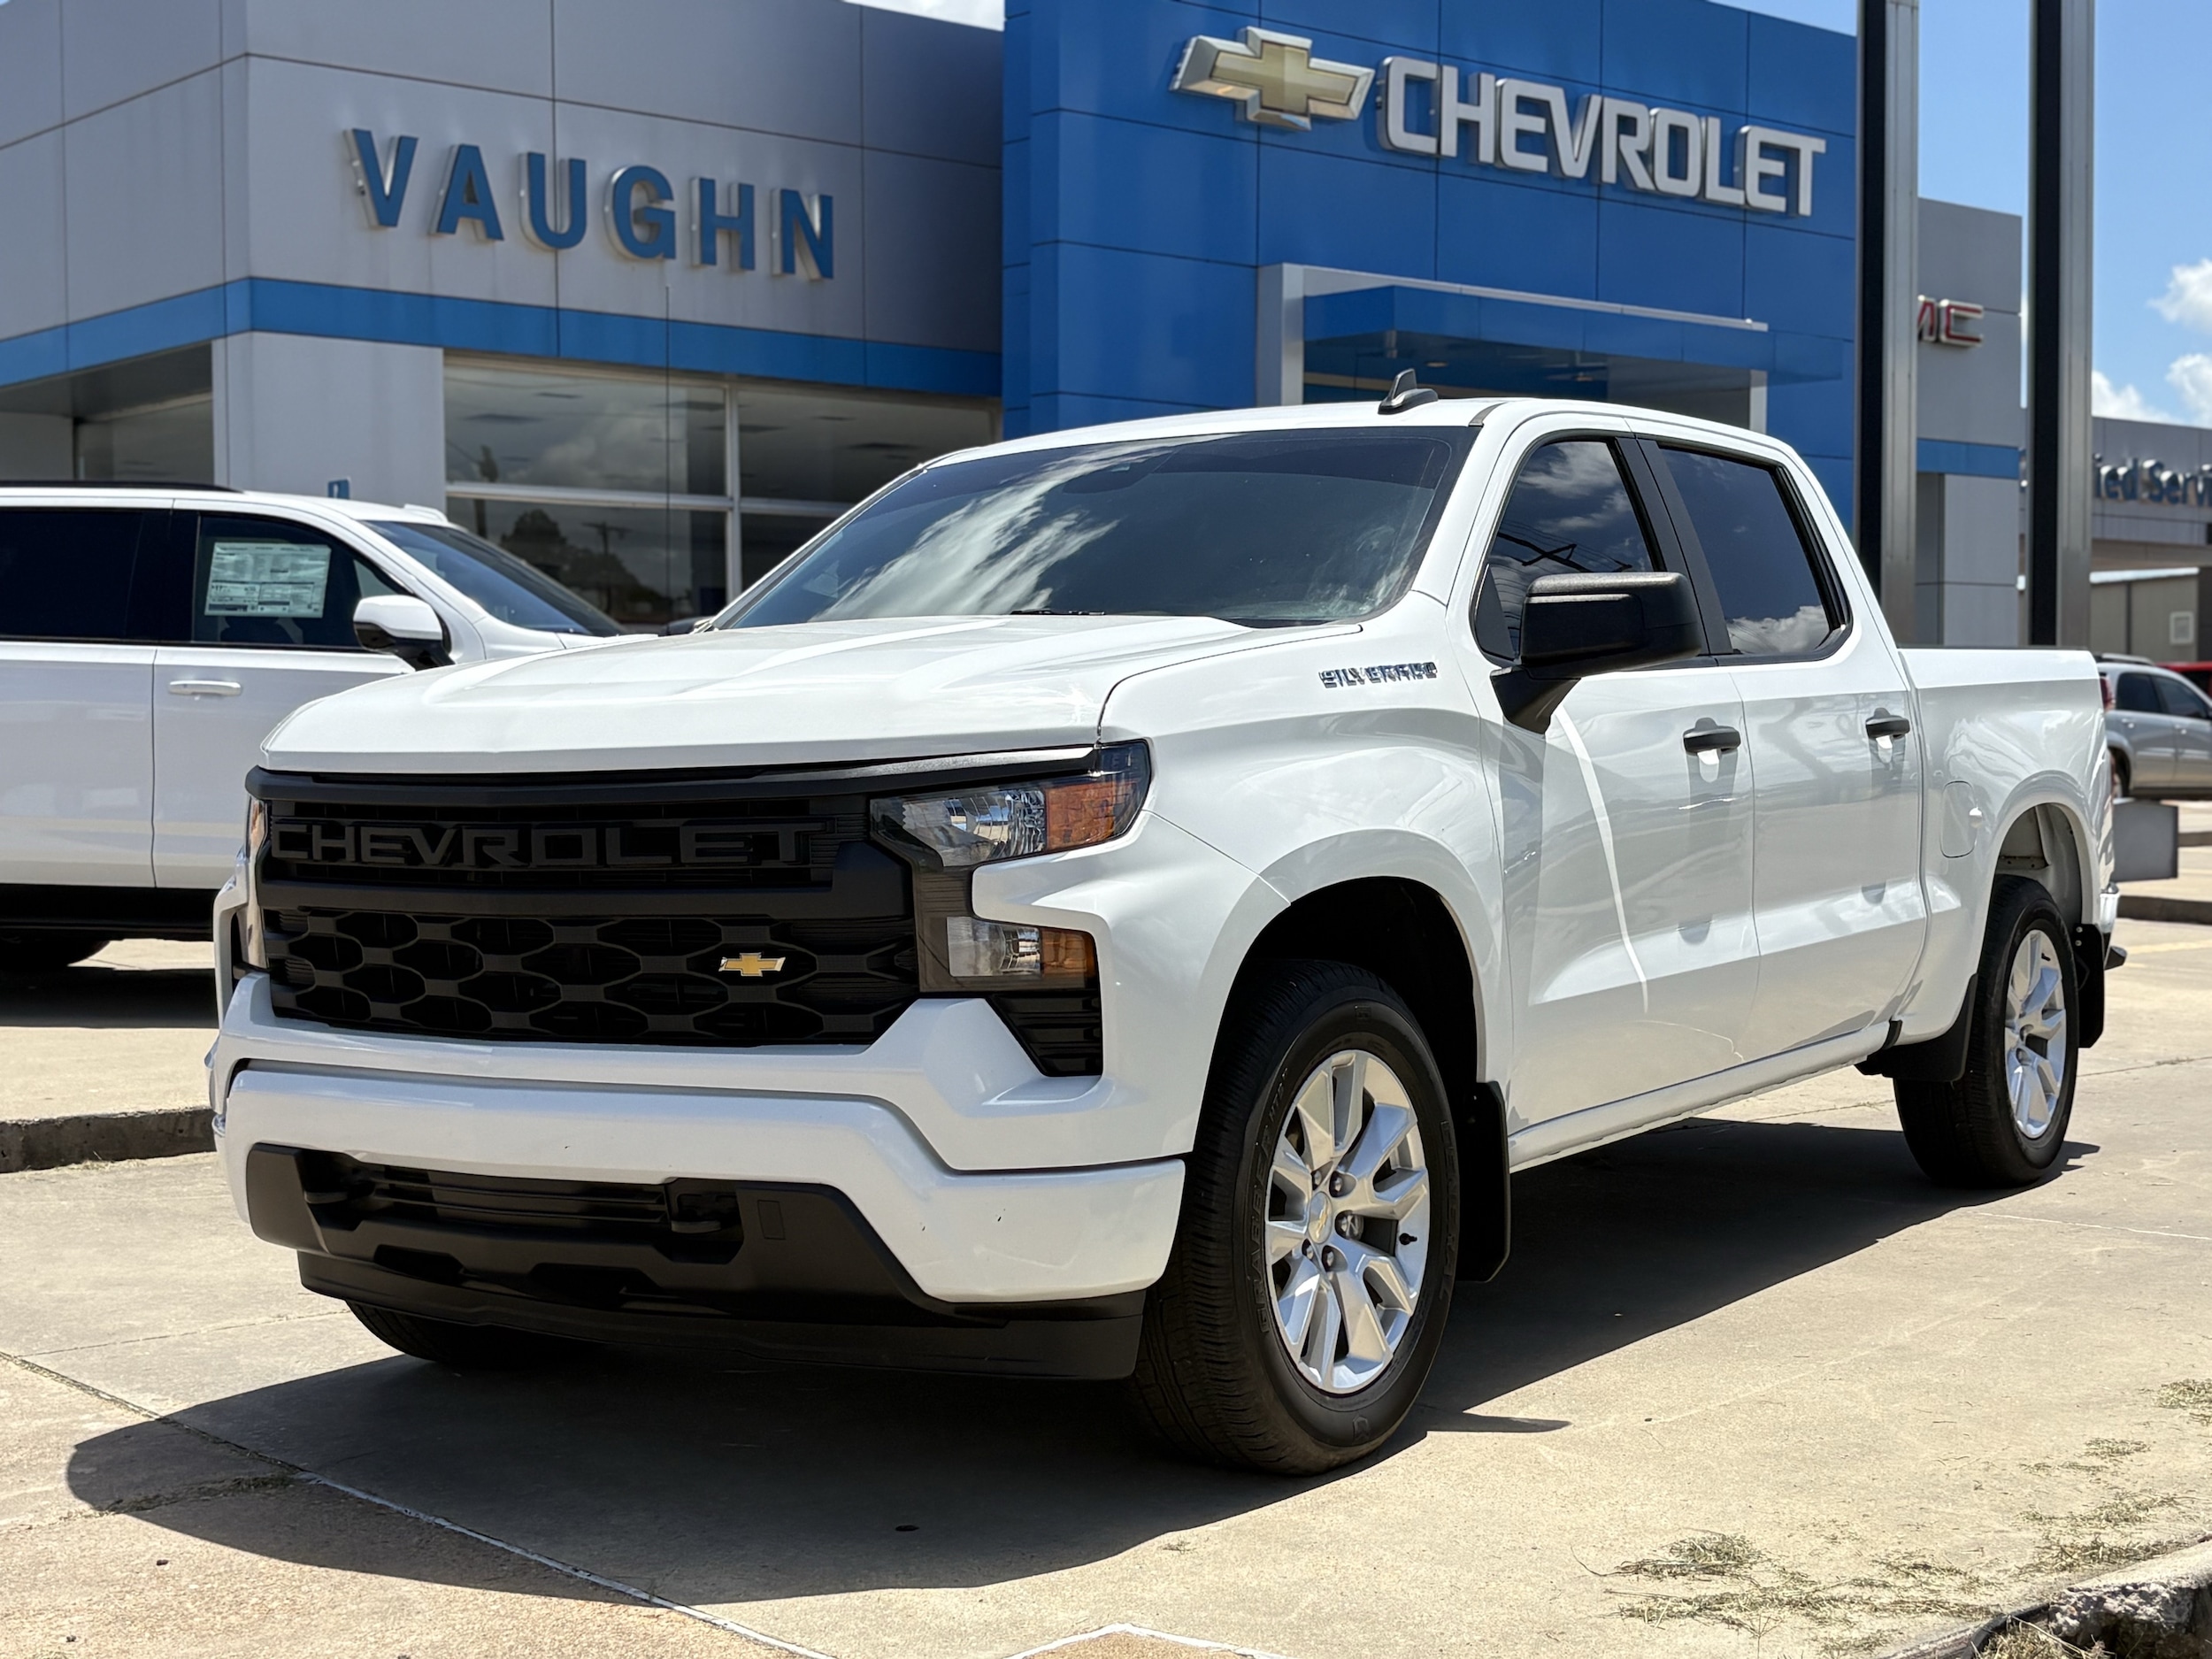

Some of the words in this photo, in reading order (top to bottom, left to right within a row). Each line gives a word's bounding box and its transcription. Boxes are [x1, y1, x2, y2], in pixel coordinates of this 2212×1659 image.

[1378, 56, 1826, 217] CHEVROLET
[346, 128, 833, 280] VAUGHN
[1916, 295, 1984, 347] MC
[1318, 661, 1439, 688] SILVERADO
[270, 820, 830, 867] CHEVROLET
[1249, 1125, 1272, 1333] GRABBER
